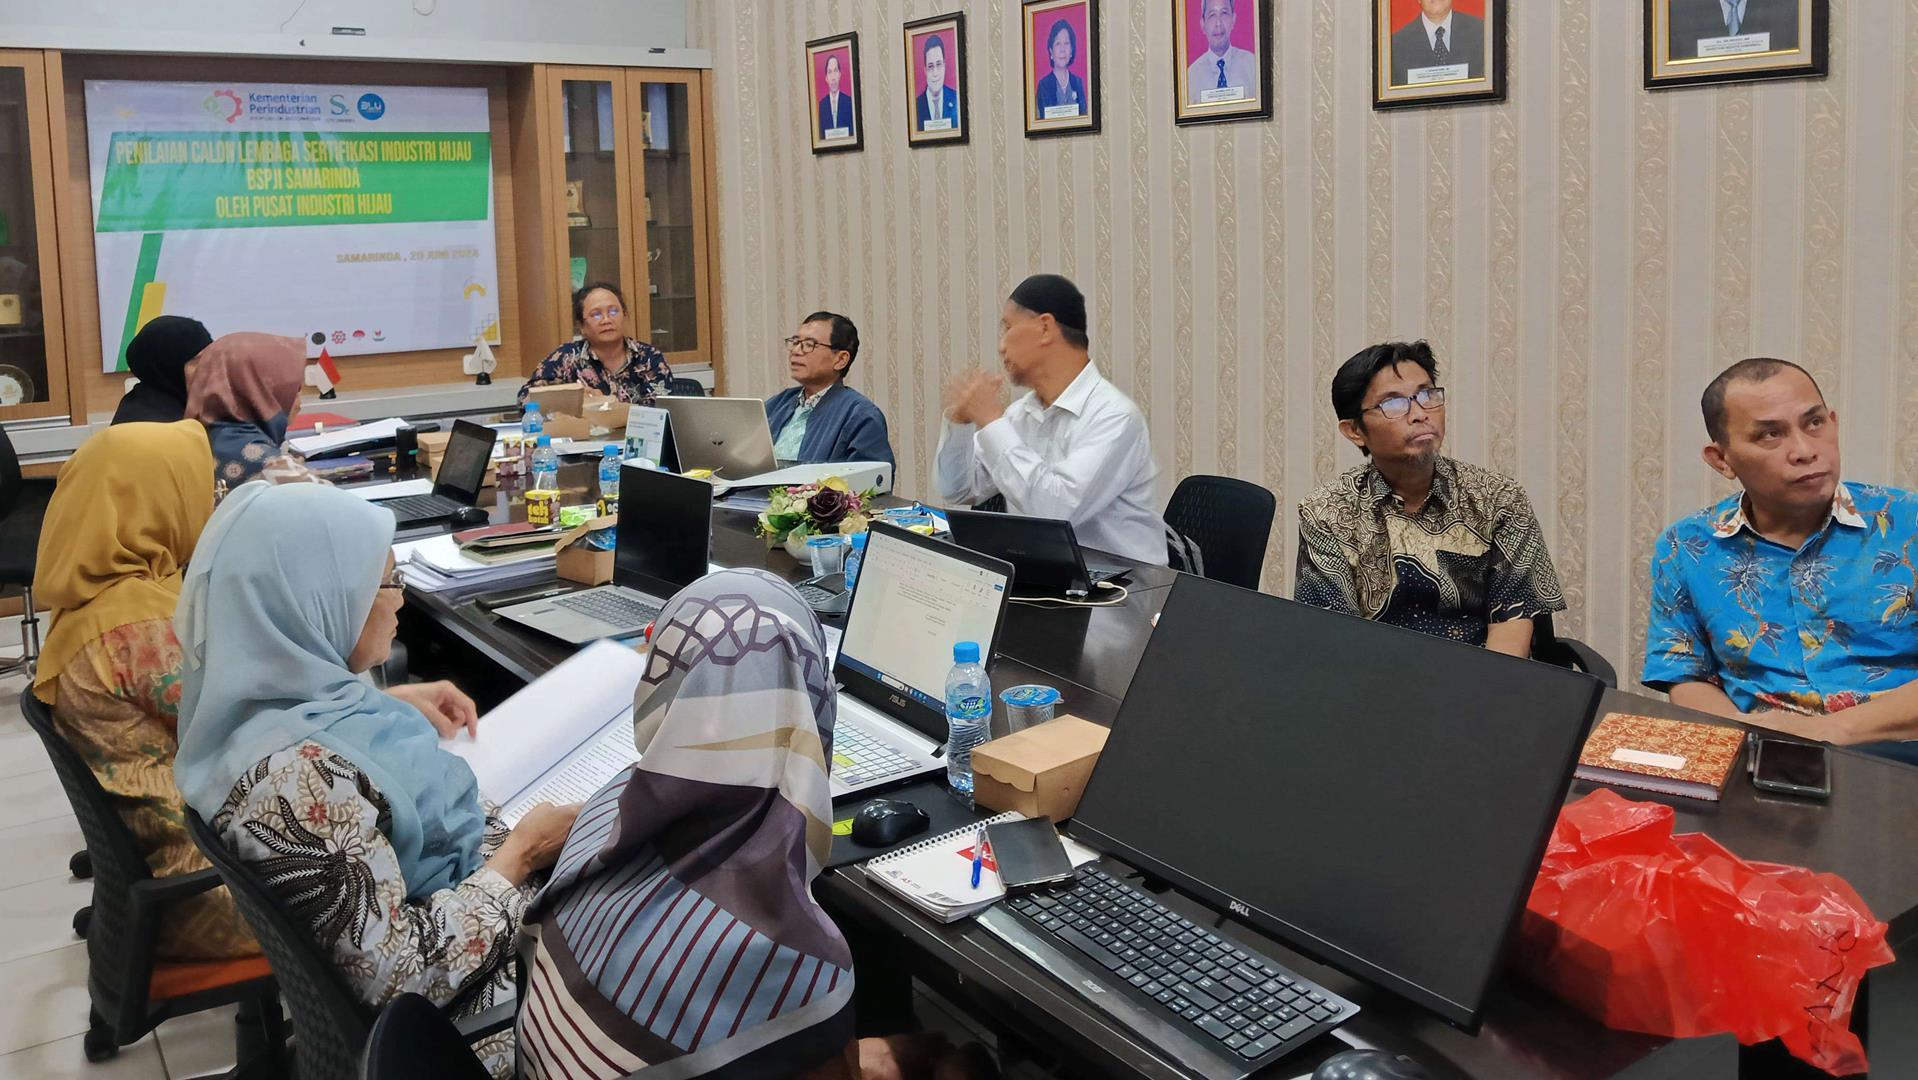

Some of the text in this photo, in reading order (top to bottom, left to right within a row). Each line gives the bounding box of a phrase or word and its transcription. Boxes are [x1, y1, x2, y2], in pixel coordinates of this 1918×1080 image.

[249, 93, 317, 103] Kementerian
[249, 104, 321, 114] Perindustrian
[115, 140, 472, 164] PENILAIAN CALON LEMBAGA SERTIFIKASI INDUSTRI HIJAU
[247, 167, 361, 190] BSPJI SAMARINDA
[215, 192, 393, 218] OLEH PUSAT INDUSTRI HIJAU
[888, 694, 907, 708] ASUS
[1229, 900, 1250, 917] DELL
[1082, 979, 1107, 993] acer
